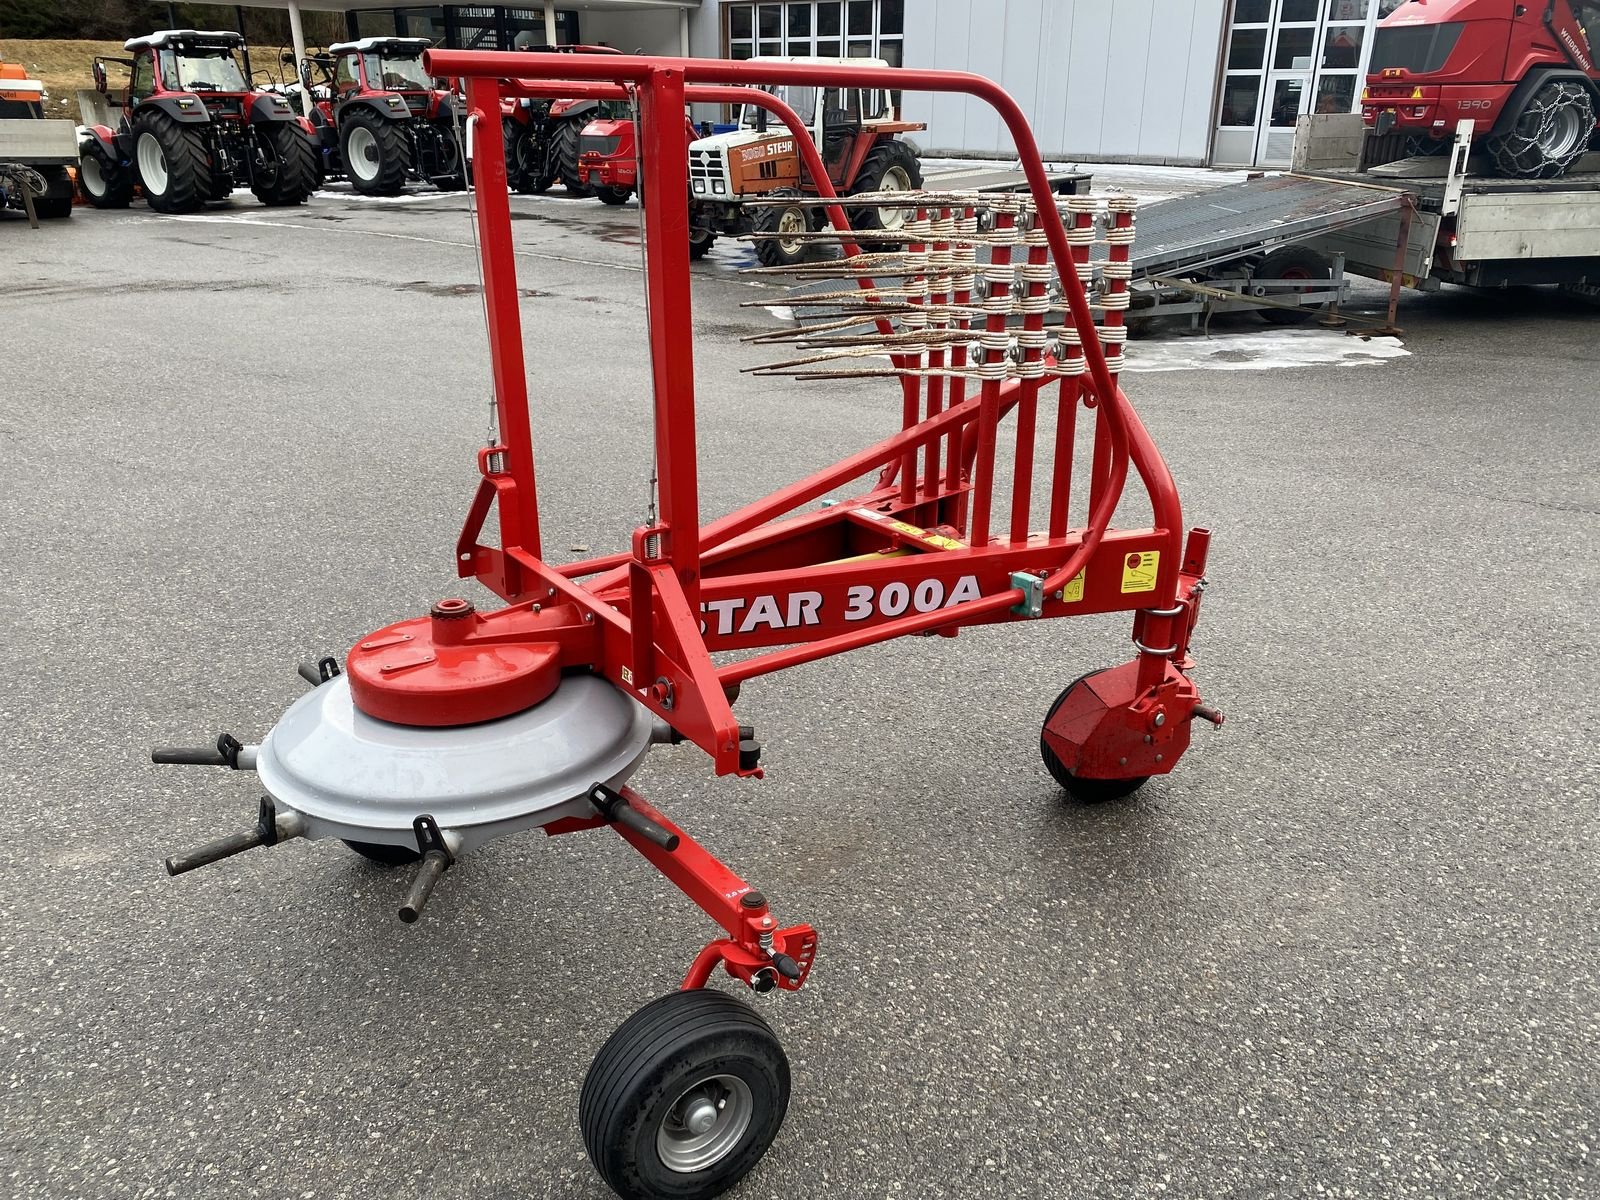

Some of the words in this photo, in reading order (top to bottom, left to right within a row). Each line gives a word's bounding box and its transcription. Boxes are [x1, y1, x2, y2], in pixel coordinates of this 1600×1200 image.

[1561, 27, 1591, 70] WEIDEMANN
[1457, 100, 1492, 109] 1390
[767, 140, 793, 156] STEYR
[844, 575, 982, 621] 300A
